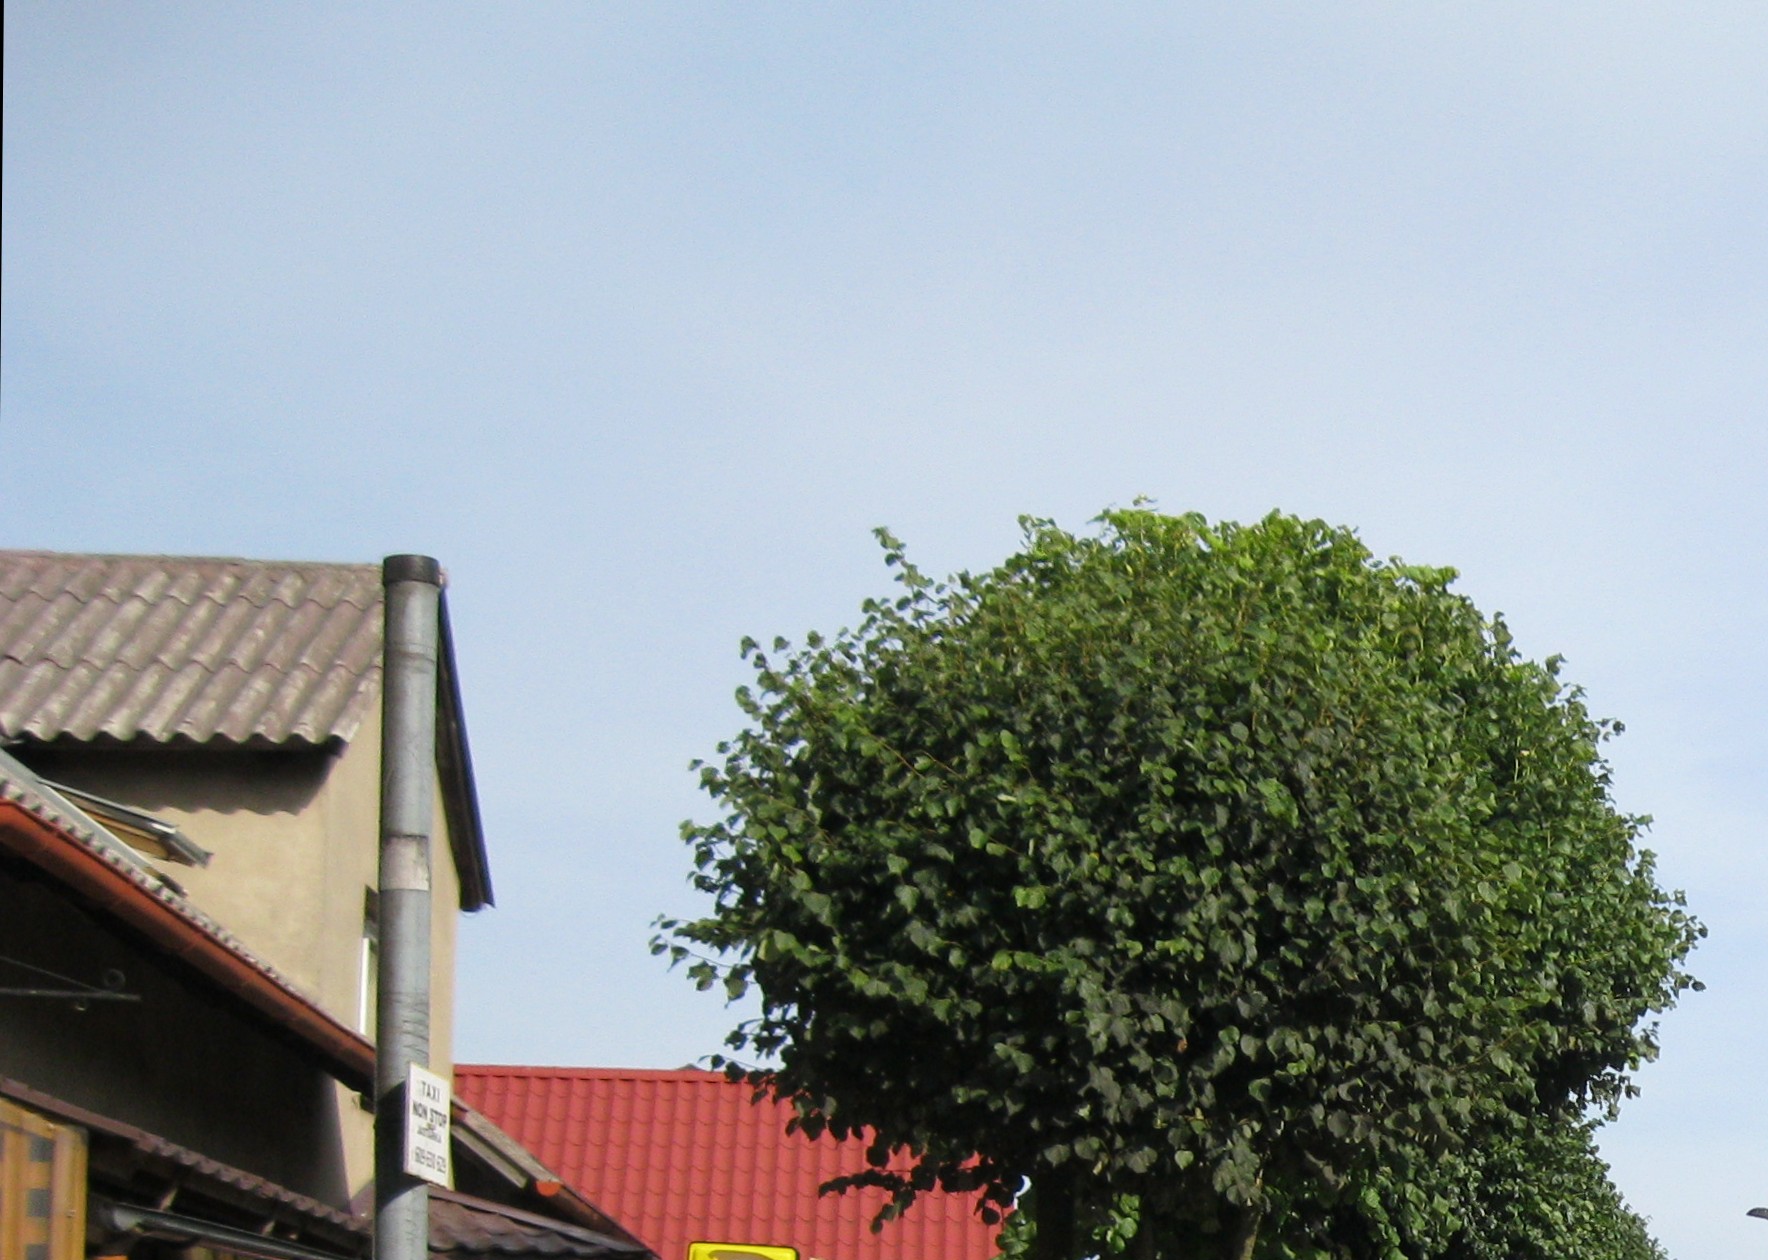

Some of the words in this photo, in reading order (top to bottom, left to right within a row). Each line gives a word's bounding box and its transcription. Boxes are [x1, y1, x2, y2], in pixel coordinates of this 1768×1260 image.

[421, 1081, 441, 1103] TAXI
[412, 1100, 429, 1119] NON
[430, 1107, 448, 1128] STOP
